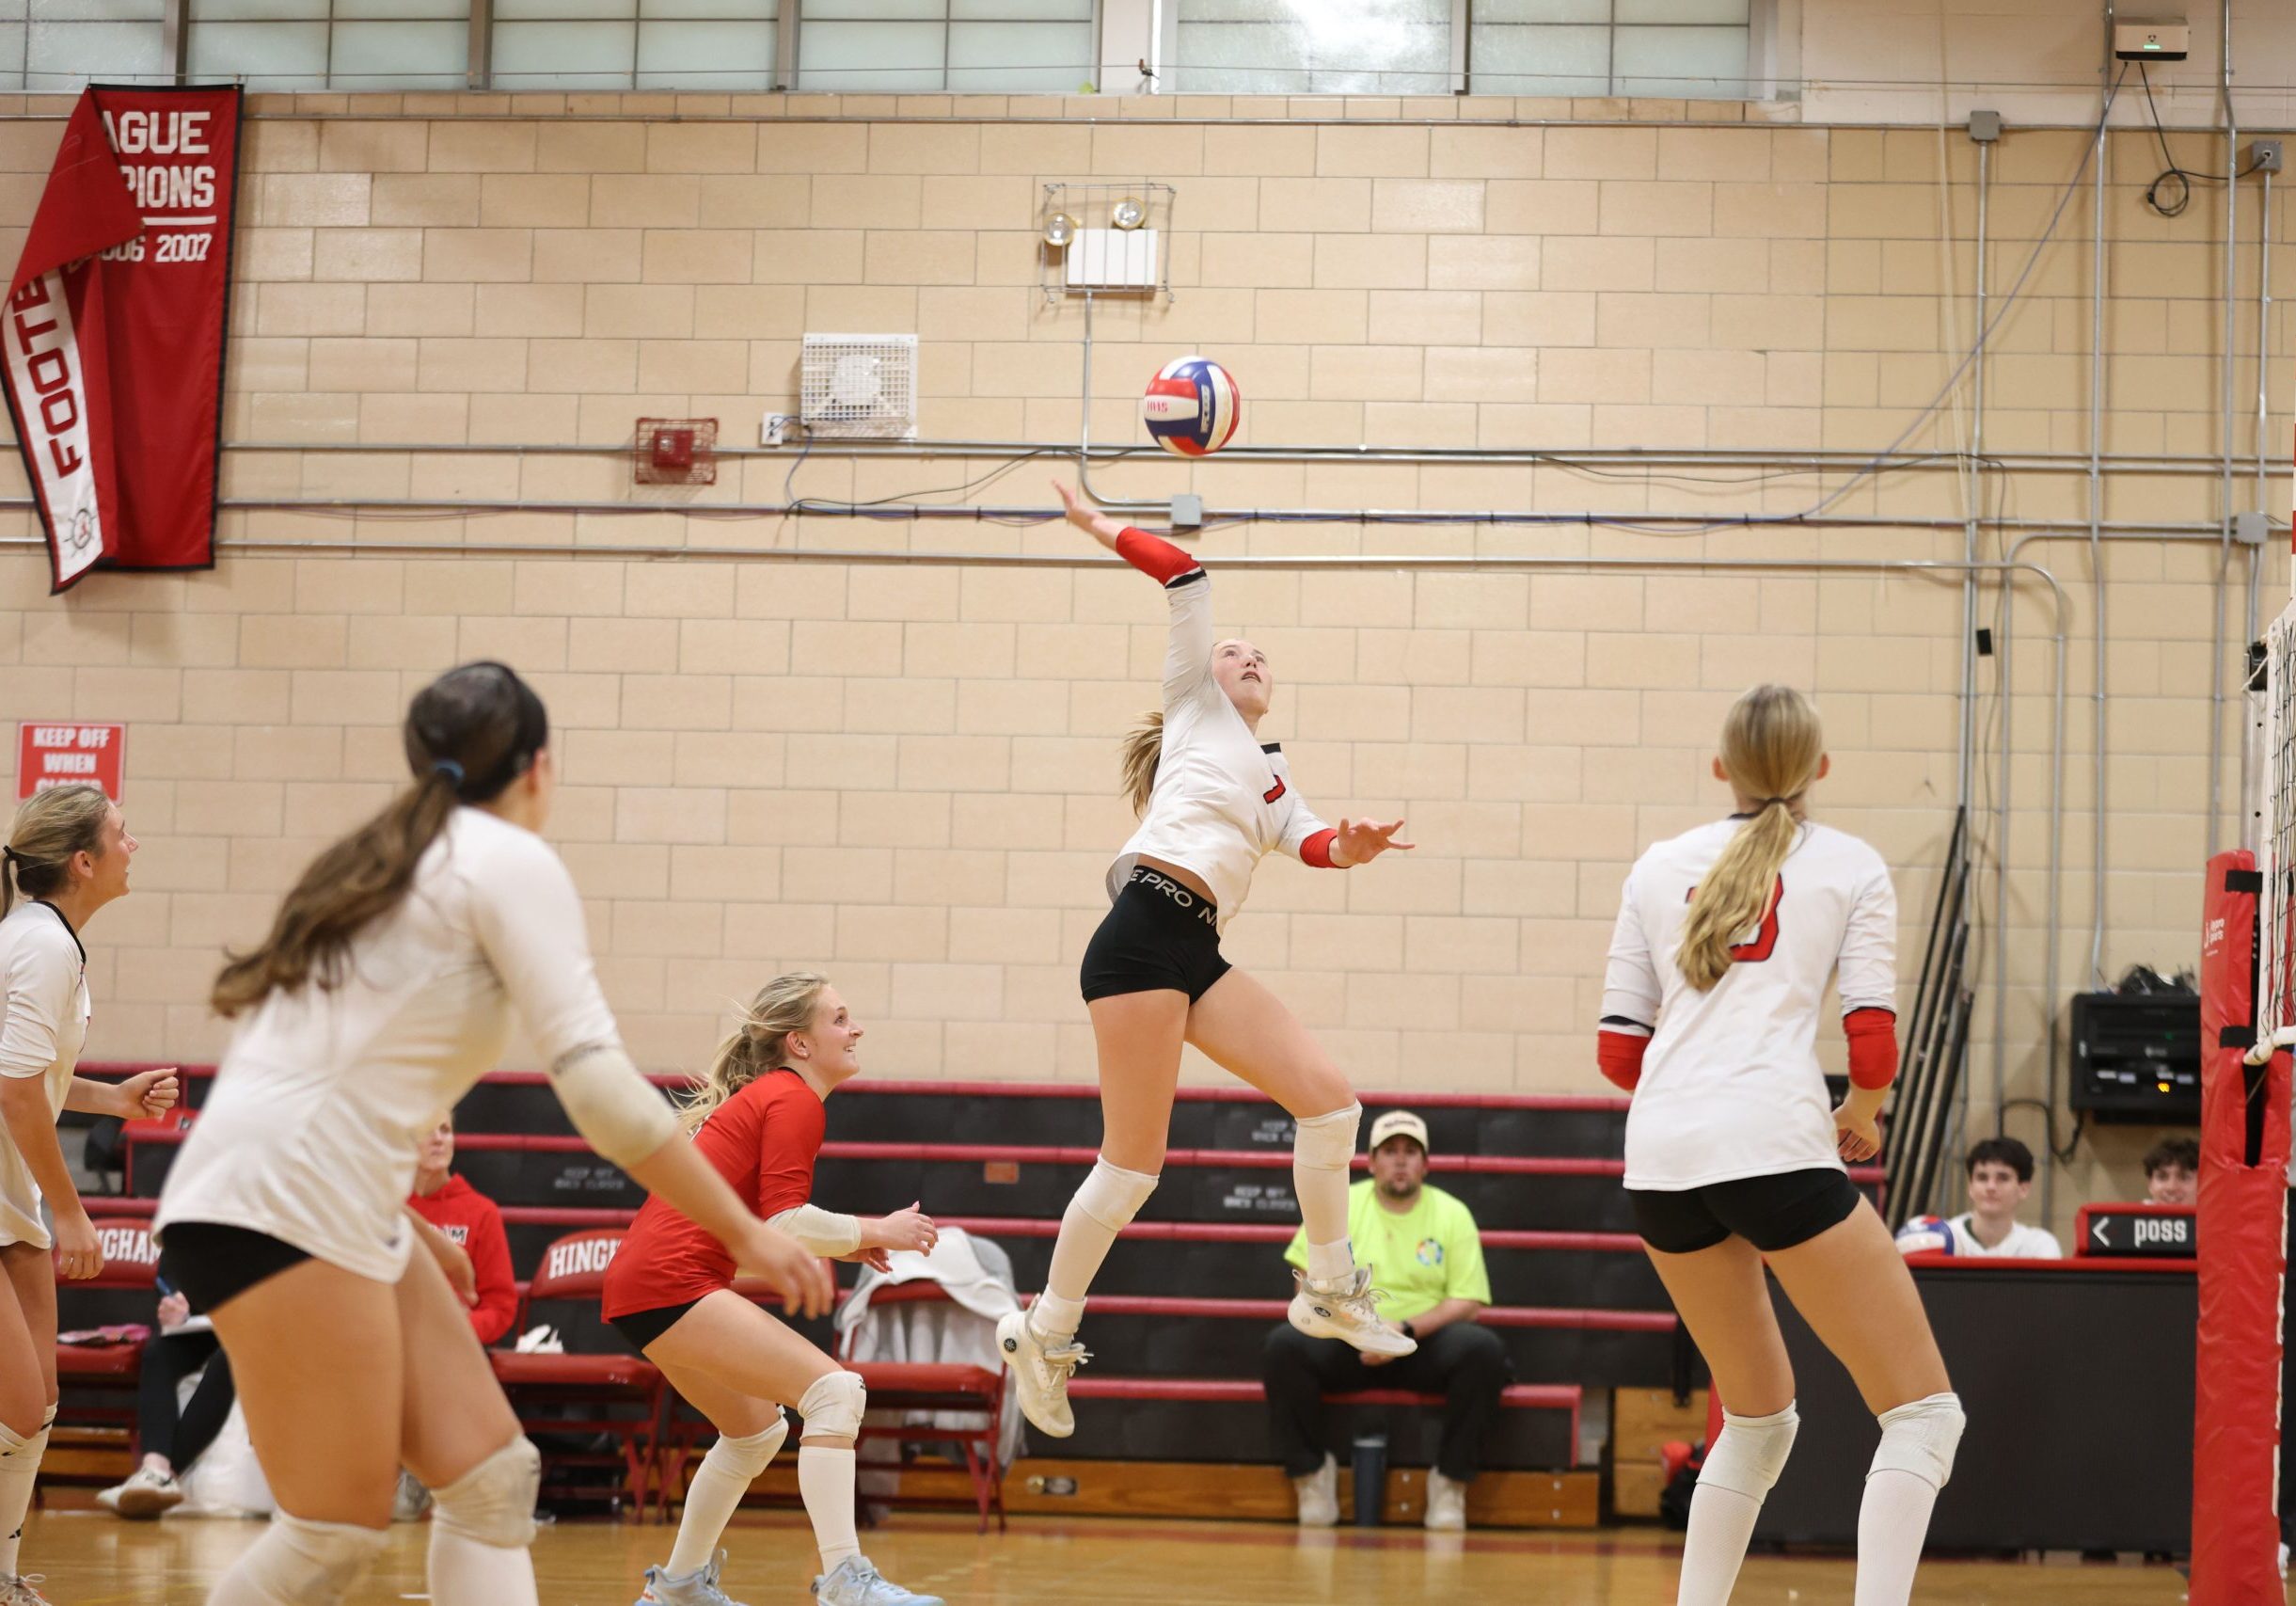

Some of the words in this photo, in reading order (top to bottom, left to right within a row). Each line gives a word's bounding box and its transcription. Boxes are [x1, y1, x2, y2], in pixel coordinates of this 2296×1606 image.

[154, 232, 212, 263] 2007
[33, 727, 75, 748] KEEP
[77, 728, 110, 749] OFF
[43, 753, 97, 773] WHEN
[1139, 872, 1193, 908] PRO
[1197, 906, 1218, 927] N
